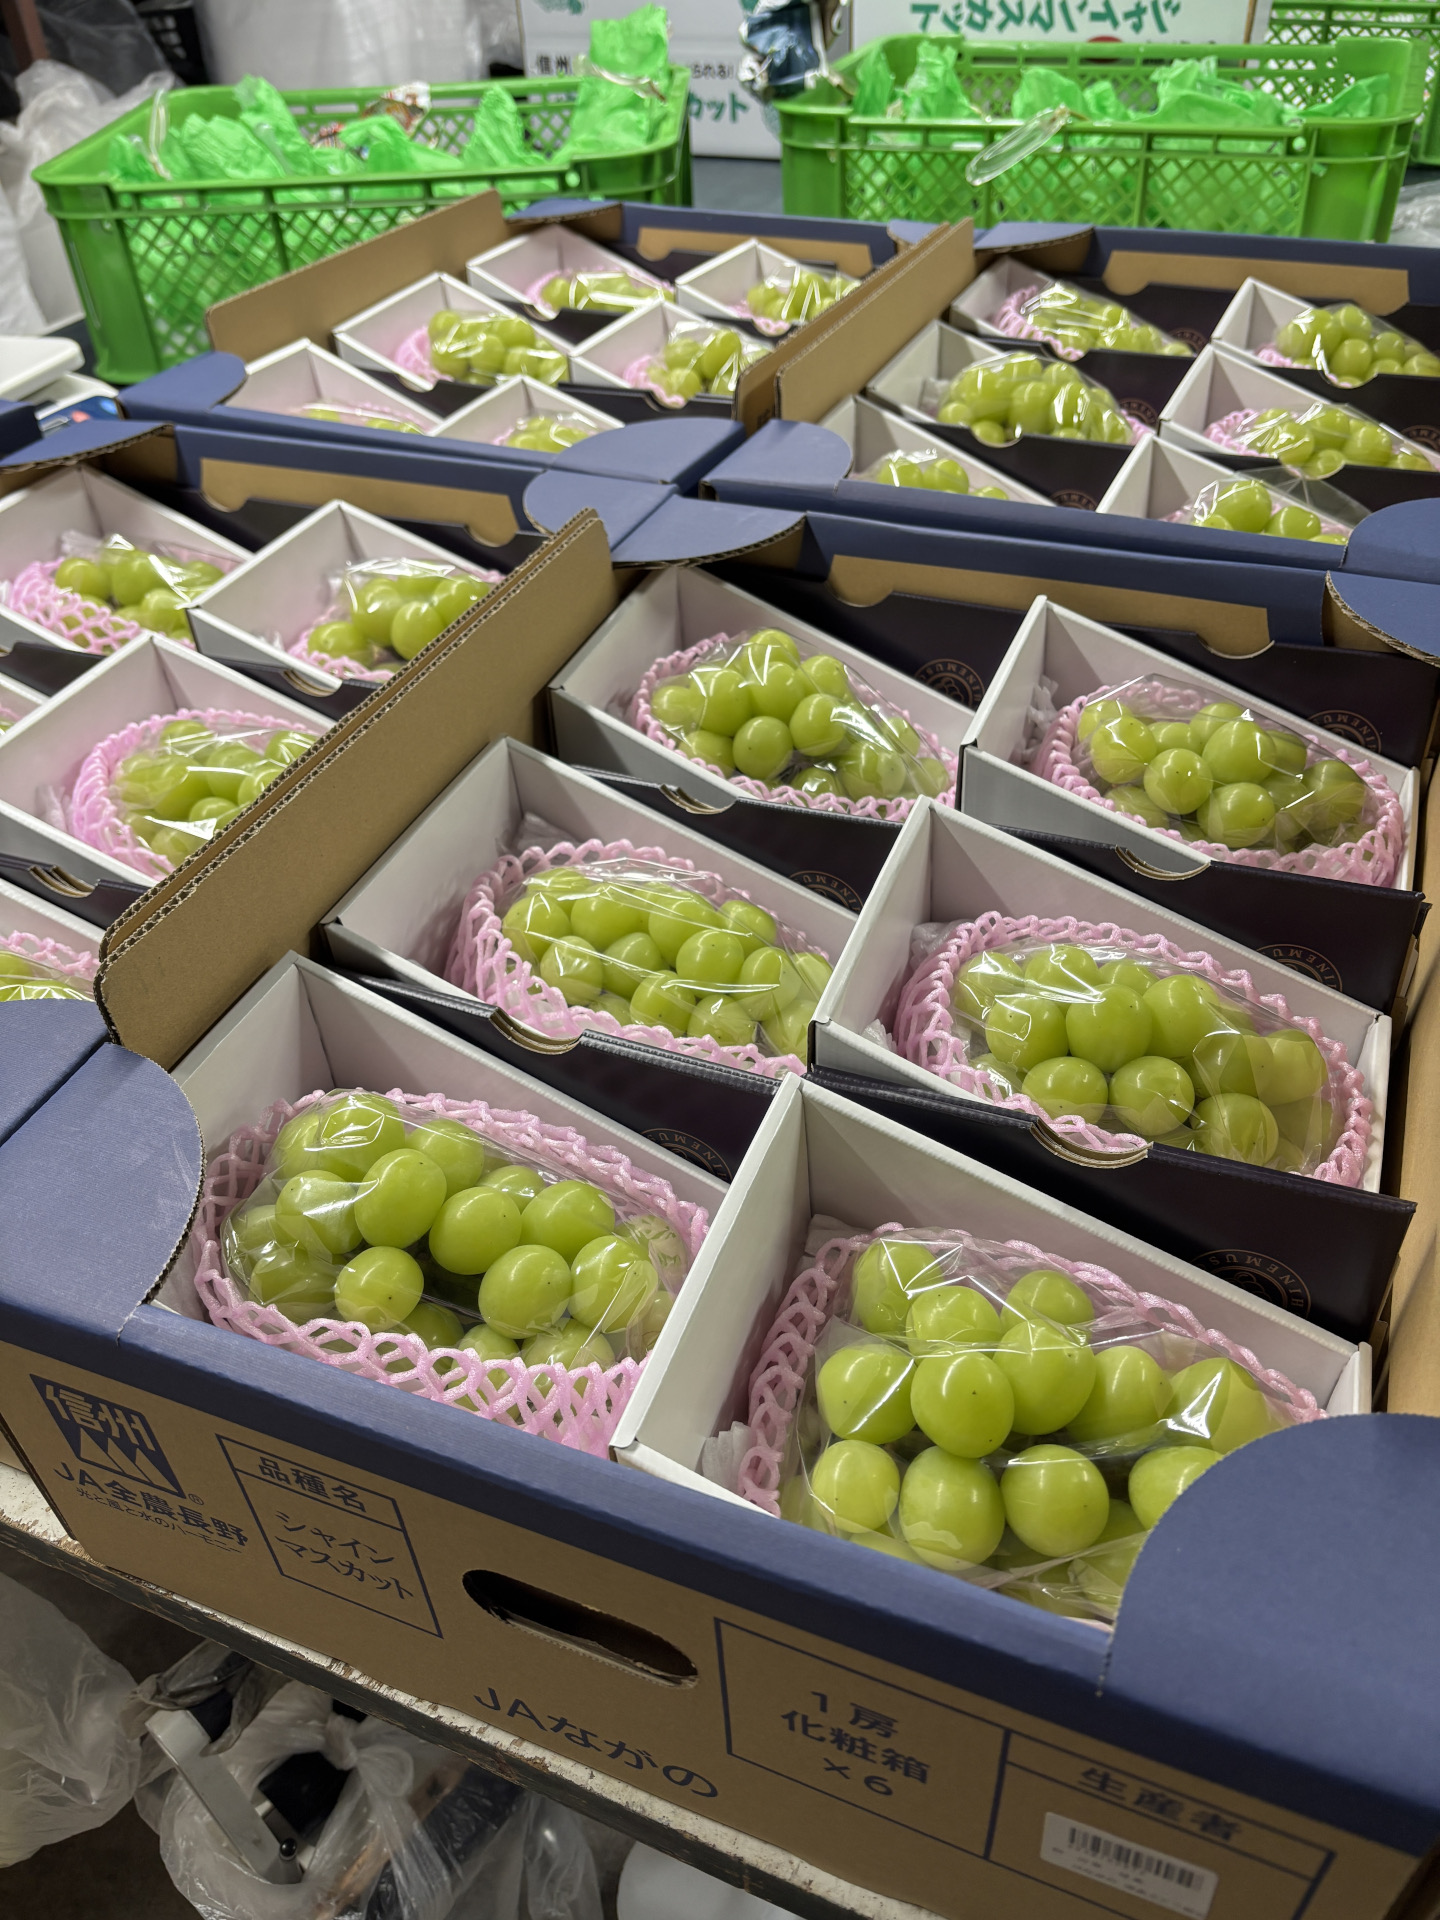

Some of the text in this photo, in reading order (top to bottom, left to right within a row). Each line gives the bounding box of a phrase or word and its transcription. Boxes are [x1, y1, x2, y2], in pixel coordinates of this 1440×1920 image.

[46, 1385, 156, 1452] 信州
[53, 1461, 248, 1547] JA全農長野
[258, 1456, 367, 1514] 品種名
[274, 1536, 414, 1600] マスカット
[275, 1510, 396, 1564] シャイン
[473, 1687, 719, 1799] JAながの
[780, 1710, 931, 1784] 化粧箱
[1077, 1766, 1242, 1842] 生産者
